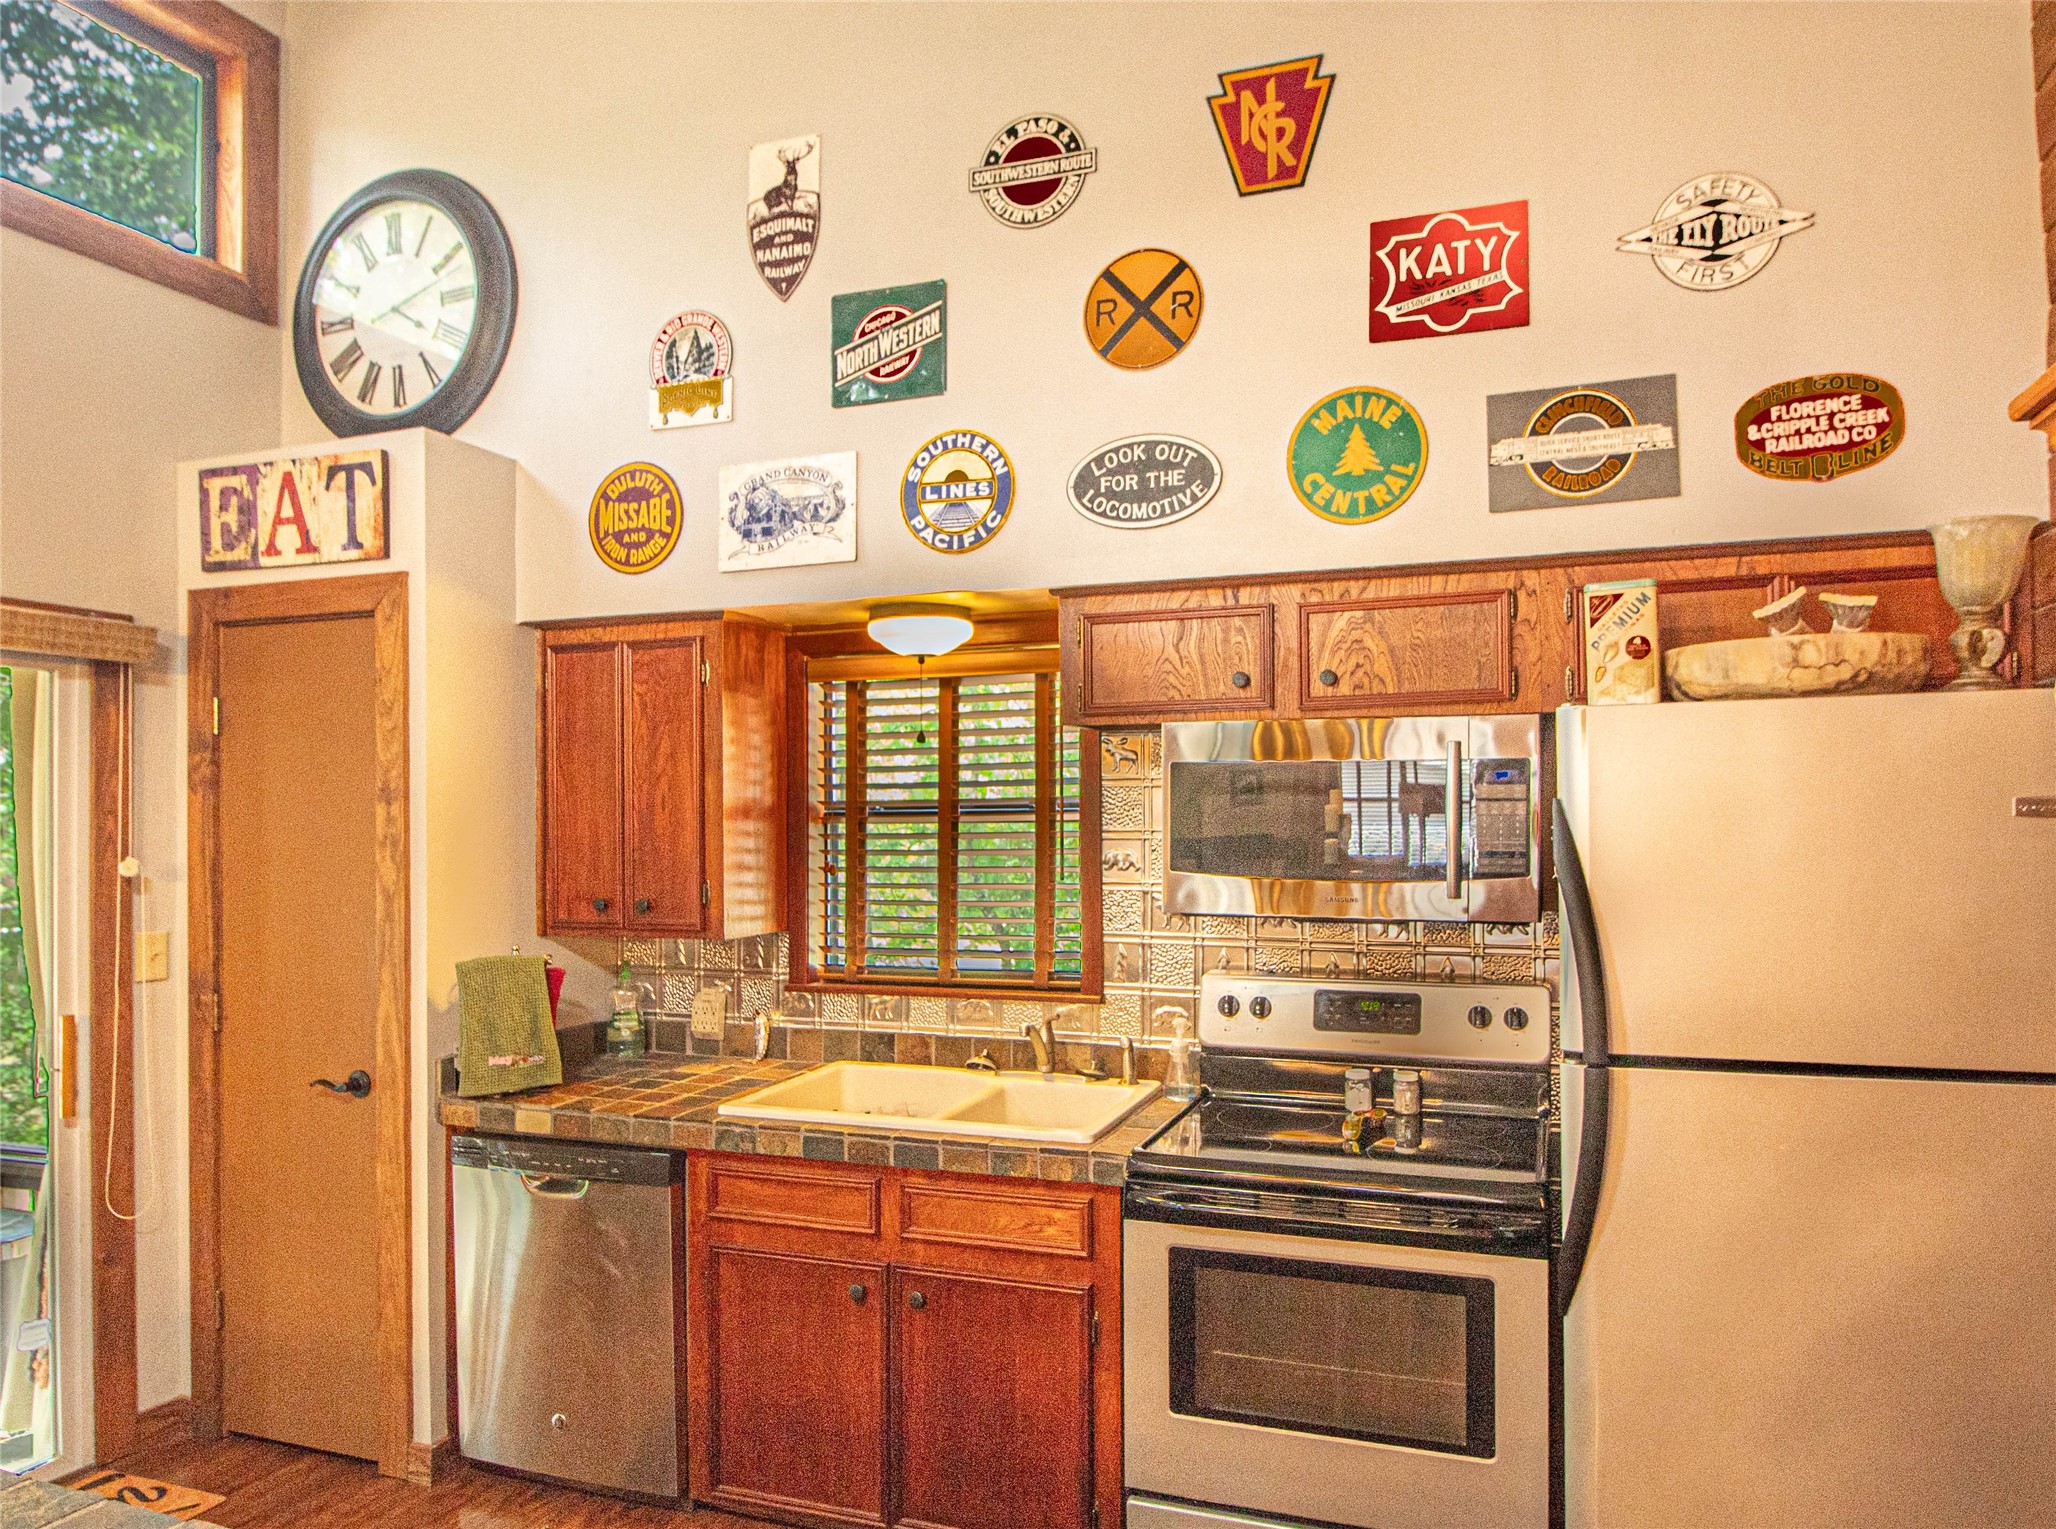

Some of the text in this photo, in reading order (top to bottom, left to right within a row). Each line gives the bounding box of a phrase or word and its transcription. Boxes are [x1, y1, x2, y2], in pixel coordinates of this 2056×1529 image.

[991, 132, 1015, 155] EL
[1014, 119, 1059, 138] PASO
[973, 153, 1092, 186] SOUTHWESTERN ROUTE
[985, 174, 1080, 223] SOUTHWESTERN
[1676, 178, 1759, 208] SAFETY
[752, 217, 815, 244] ESQUIMALT
[774, 233, 794, 244] AND
[1718, 213, 1780, 245] ROUTE
[756, 242, 810, 260] NANAIMO
[1399, 235, 1498, 282] KATY
[1676, 252, 1750, 281] FIRST
[764, 259, 805, 278] RAILWAY
[1395, 271, 1504, 313] MISSOURI KANSAS TEXAS
[864, 311, 896, 333] CHICAGO
[880, 355, 910, 376] RAILWAY
[1756, 376, 1880, 408] THE GOLD
[1770, 393, 1862, 421] FLORENCE
[1311, 394, 1402, 435] MAINE
[1535, 395, 1624, 433] CLINCHFIELD
[1833, 406, 1890, 429] CREEK
[1749, 432, 1893, 476] BELT LINE
[1764, 425, 1877, 453] RAILROAD CO
[907, 433, 1009, 483] SOUTHERN
[1090, 444, 1197, 477] LOOK OUT
[1541, 458, 1621, 490] RAILROAD
[606, 471, 664, 499] DULUTH
[743, 468, 828, 491] GRAND CANYON
[925, 482, 990, 499] LINES
[1100, 469, 1186, 493] FOR THE
[1303, 462, 1415, 514] CENTRAL
[203, 461, 376, 562] EAT
[599, 492, 672, 538] MISSABE
[1081, 480, 1208, 519] LOCOMOTIVE
[623, 531, 646, 543] AND
[758, 523, 815, 551] RAILWAY
[910, 510, 1001, 550] PACIFIC
[601, 532, 666, 564] IRON RANGE
